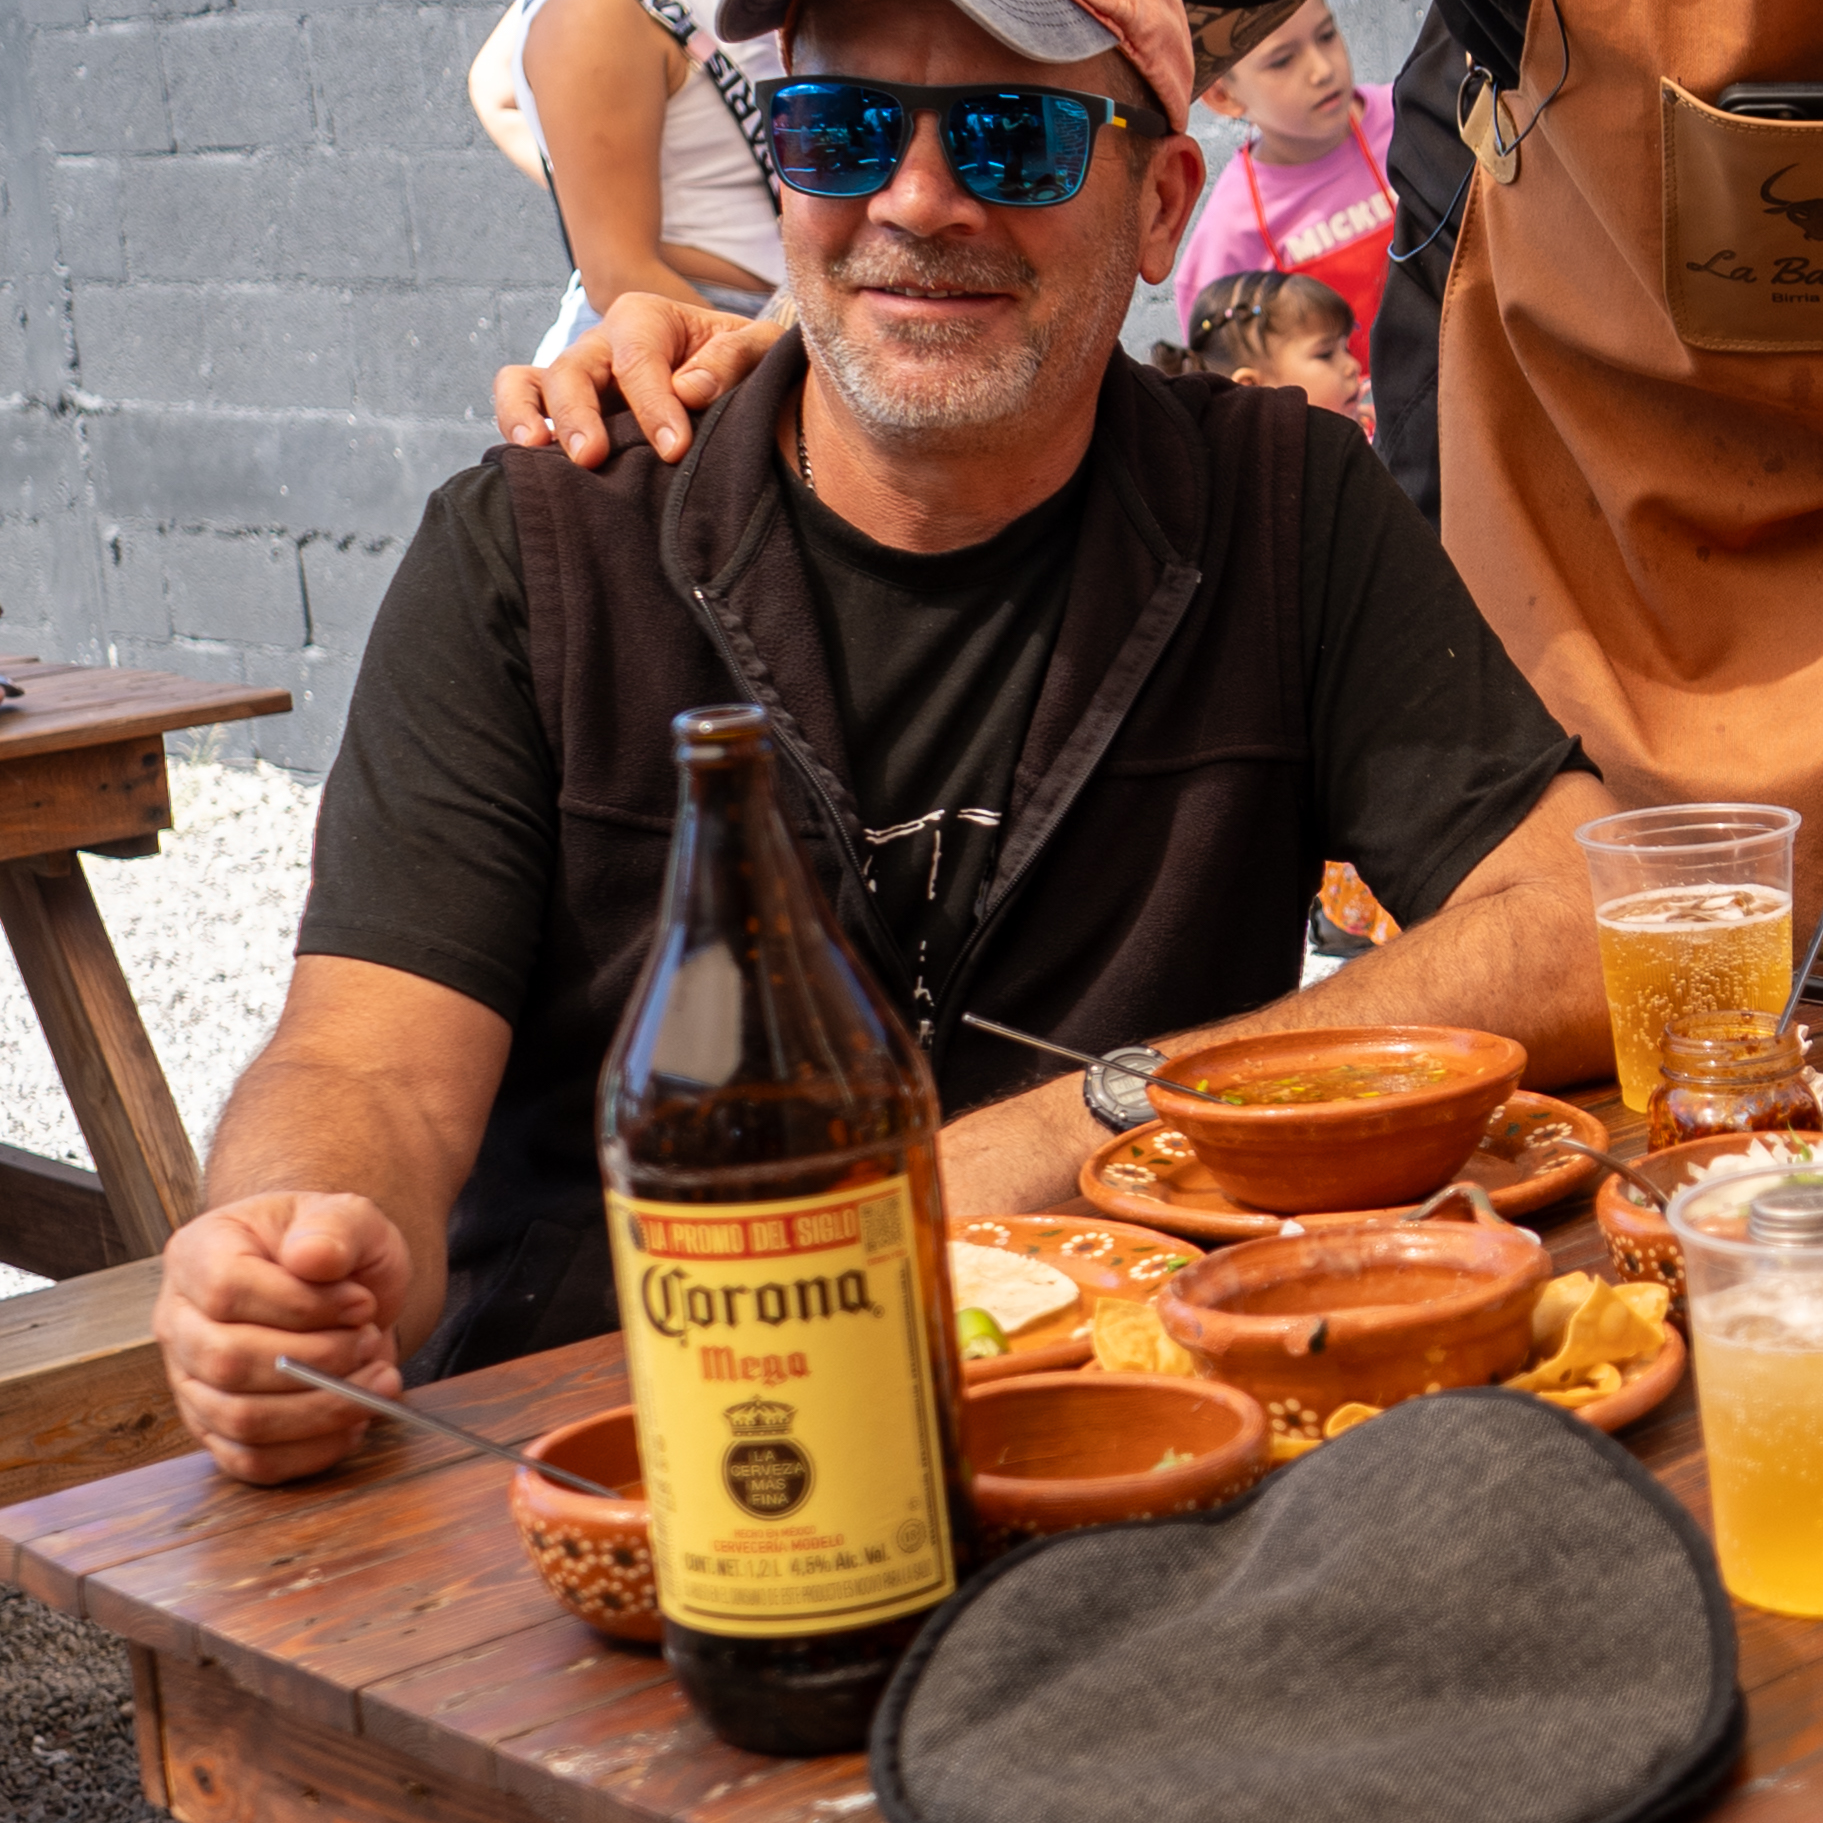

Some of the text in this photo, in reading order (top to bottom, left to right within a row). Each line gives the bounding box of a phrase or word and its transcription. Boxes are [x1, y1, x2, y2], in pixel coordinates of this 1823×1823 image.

[1686, 249, 1757, 283] La
[1771, 292, 1820, 304] Birria
[671, 1222, 745, 1255] PROMO
[751, 1219, 791, 1252] DEL
[796, 1208, 857, 1246] SIGLO
[641, 1263, 874, 1348] Corona
[700, 1345, 813, 1388] Mega
[753, 1450, 776, 1462] LA
[731, 1462, 806, 1478] CERVEZA
[751, 1492, 790, 1506] FINA
[790, 1533, 845, 1551] MODELO
